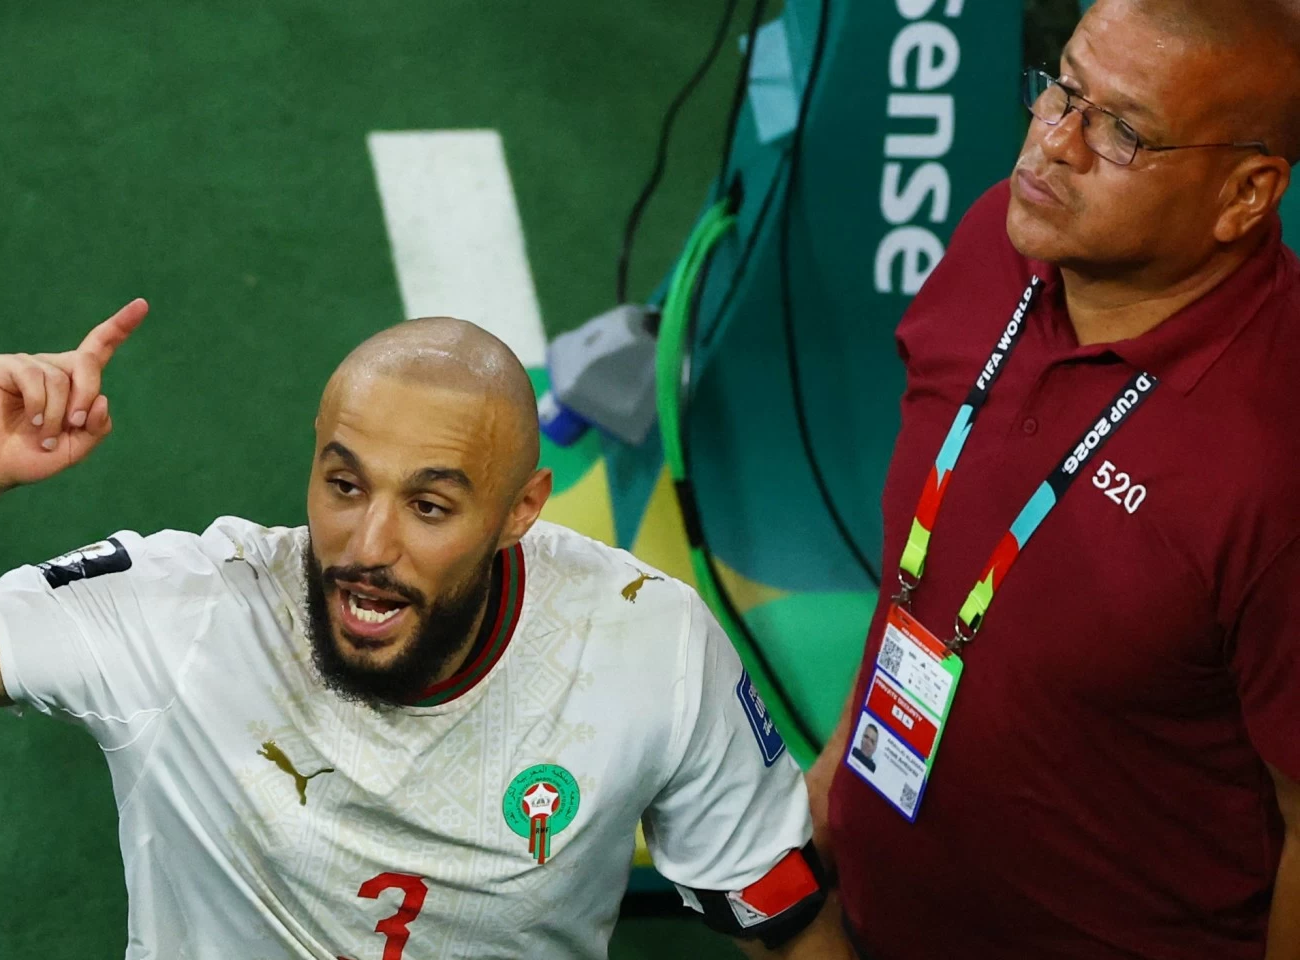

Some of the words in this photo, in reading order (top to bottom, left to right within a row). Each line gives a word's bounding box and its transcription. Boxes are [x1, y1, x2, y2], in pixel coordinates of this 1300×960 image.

[976, 352, 1003, 390] FIFA
[997, 286, 1032, 350] WORLD
[1110, 388, 1139, 423] CUP
[1063, 417, 1111, 475] 2026
[1092, 460, 1147, 514] 520
